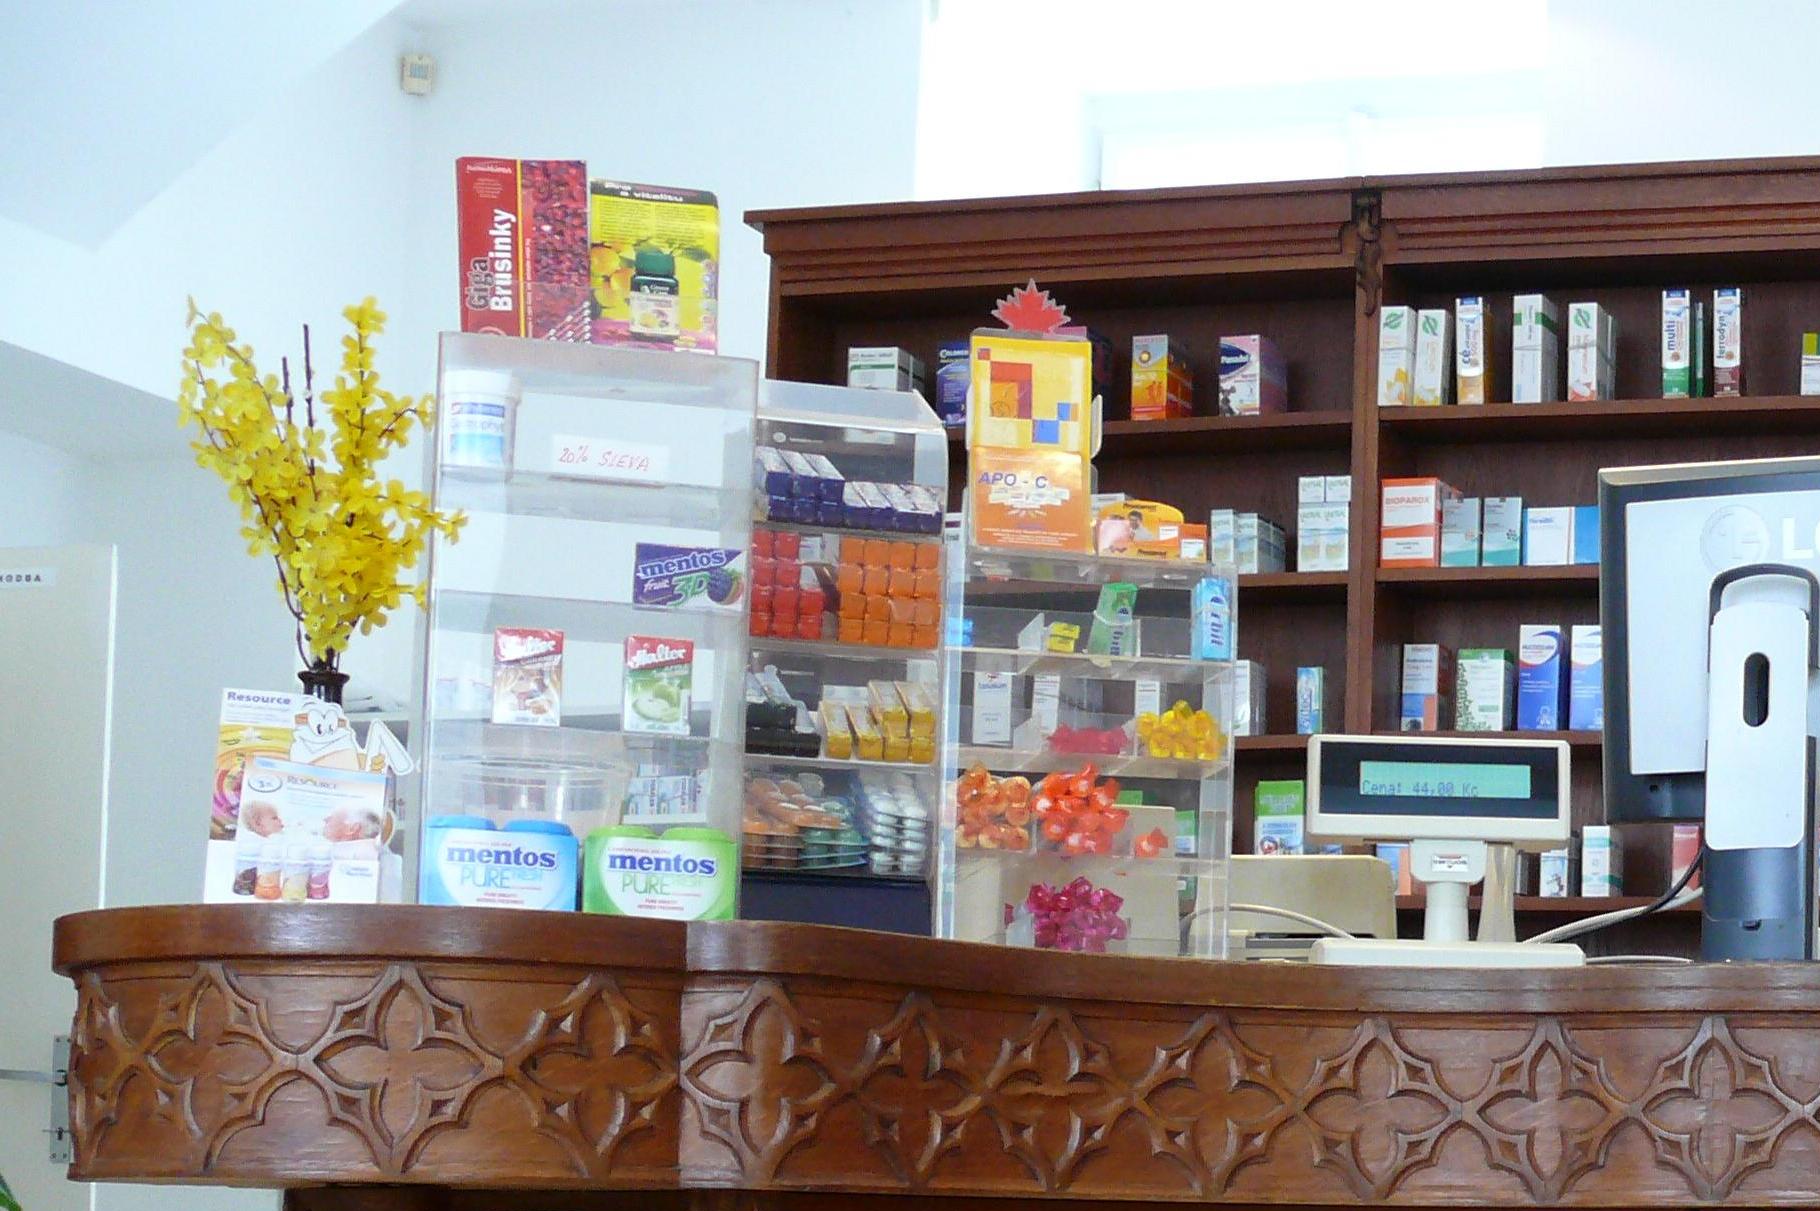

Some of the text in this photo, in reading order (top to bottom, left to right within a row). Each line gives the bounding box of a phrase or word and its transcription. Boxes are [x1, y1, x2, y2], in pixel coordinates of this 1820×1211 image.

[489, 208, 517, 311] Brusinky
[1665, 320, 1676, 350] multi
[559, 445, 588, 464] 20%
[978, 472, 1016, 487] APO
[1035, 476, 1048, 489] C
[639, 551, 726, 577] mentos
[227, 691, 291, 705] Resource
[446, 846, 556, 868] mentos
[609, 853, 715, 875] mentos
[460, 865, 511, 889] PURE
[622, 872, 672, 895] PURE
